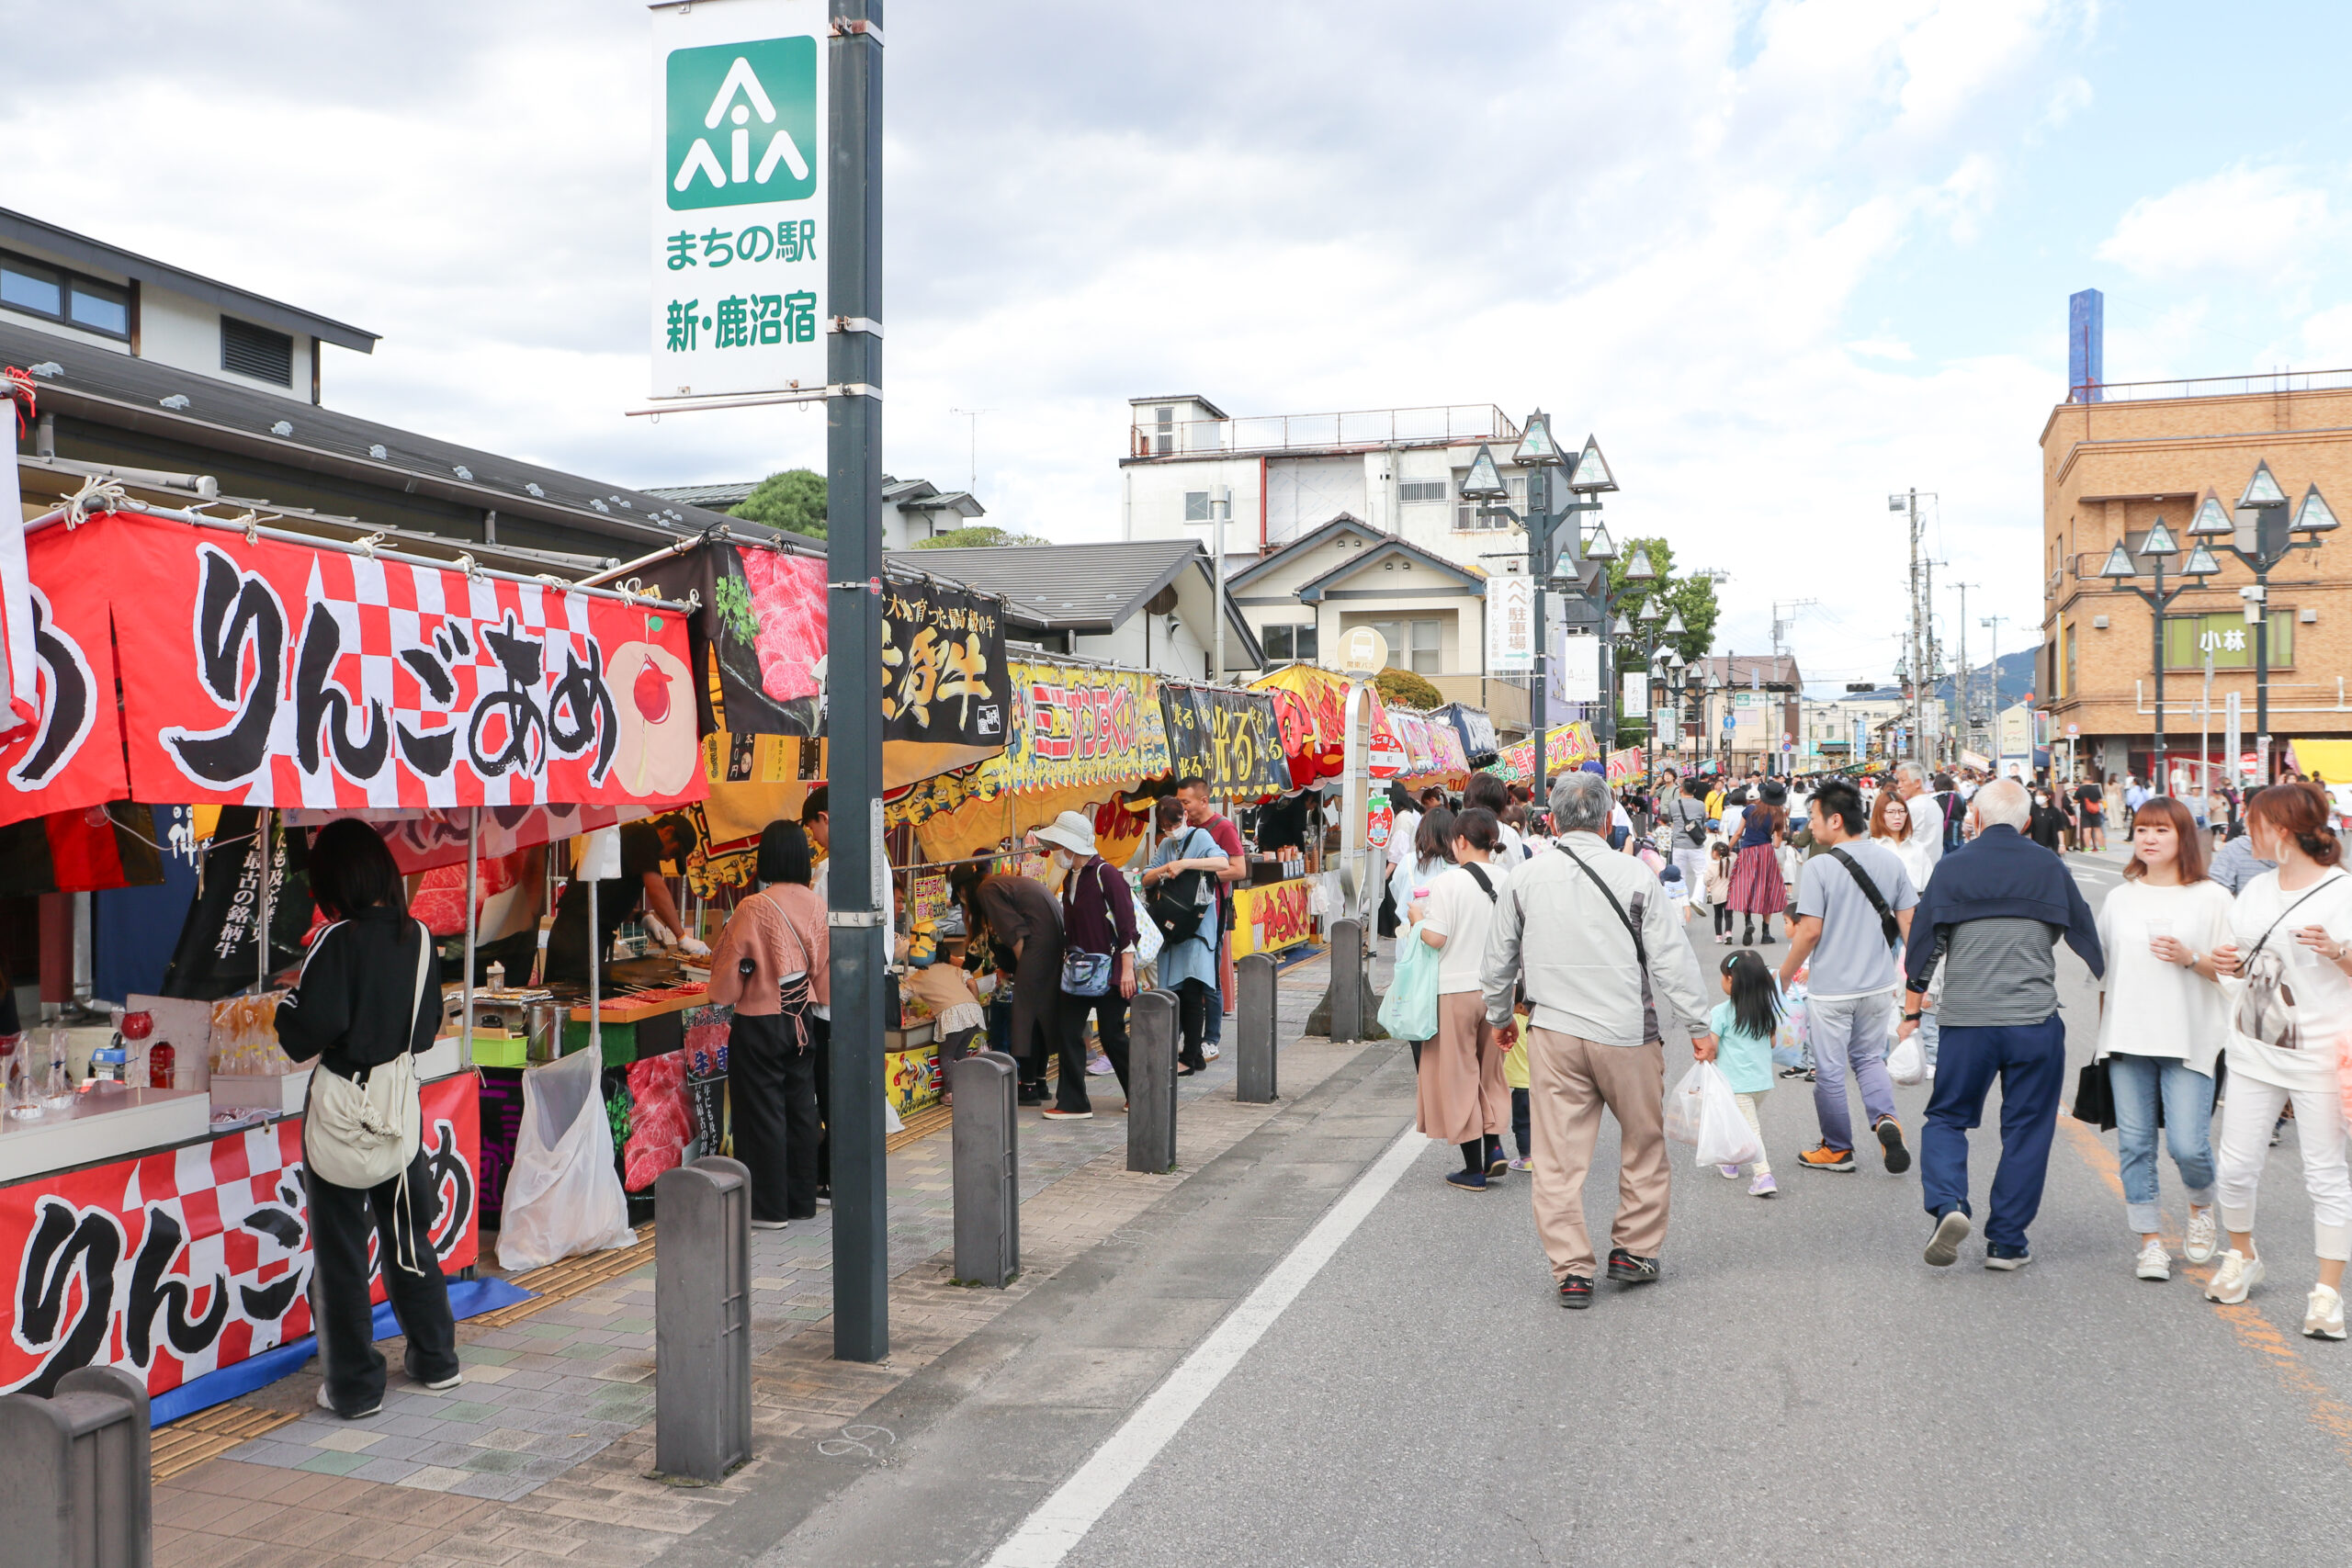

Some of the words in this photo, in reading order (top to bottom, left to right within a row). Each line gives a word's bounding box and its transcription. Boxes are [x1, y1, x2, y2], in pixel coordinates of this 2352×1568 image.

[667, 220, 816, 271] まちの駅
[667, 289, 816, 352] 新・鹿沼宿
[162, 545, 621, 789] りんごあめ
[2199, 629, 2245, 651] 小林
[1213, 705, 1252, 784] 光る
